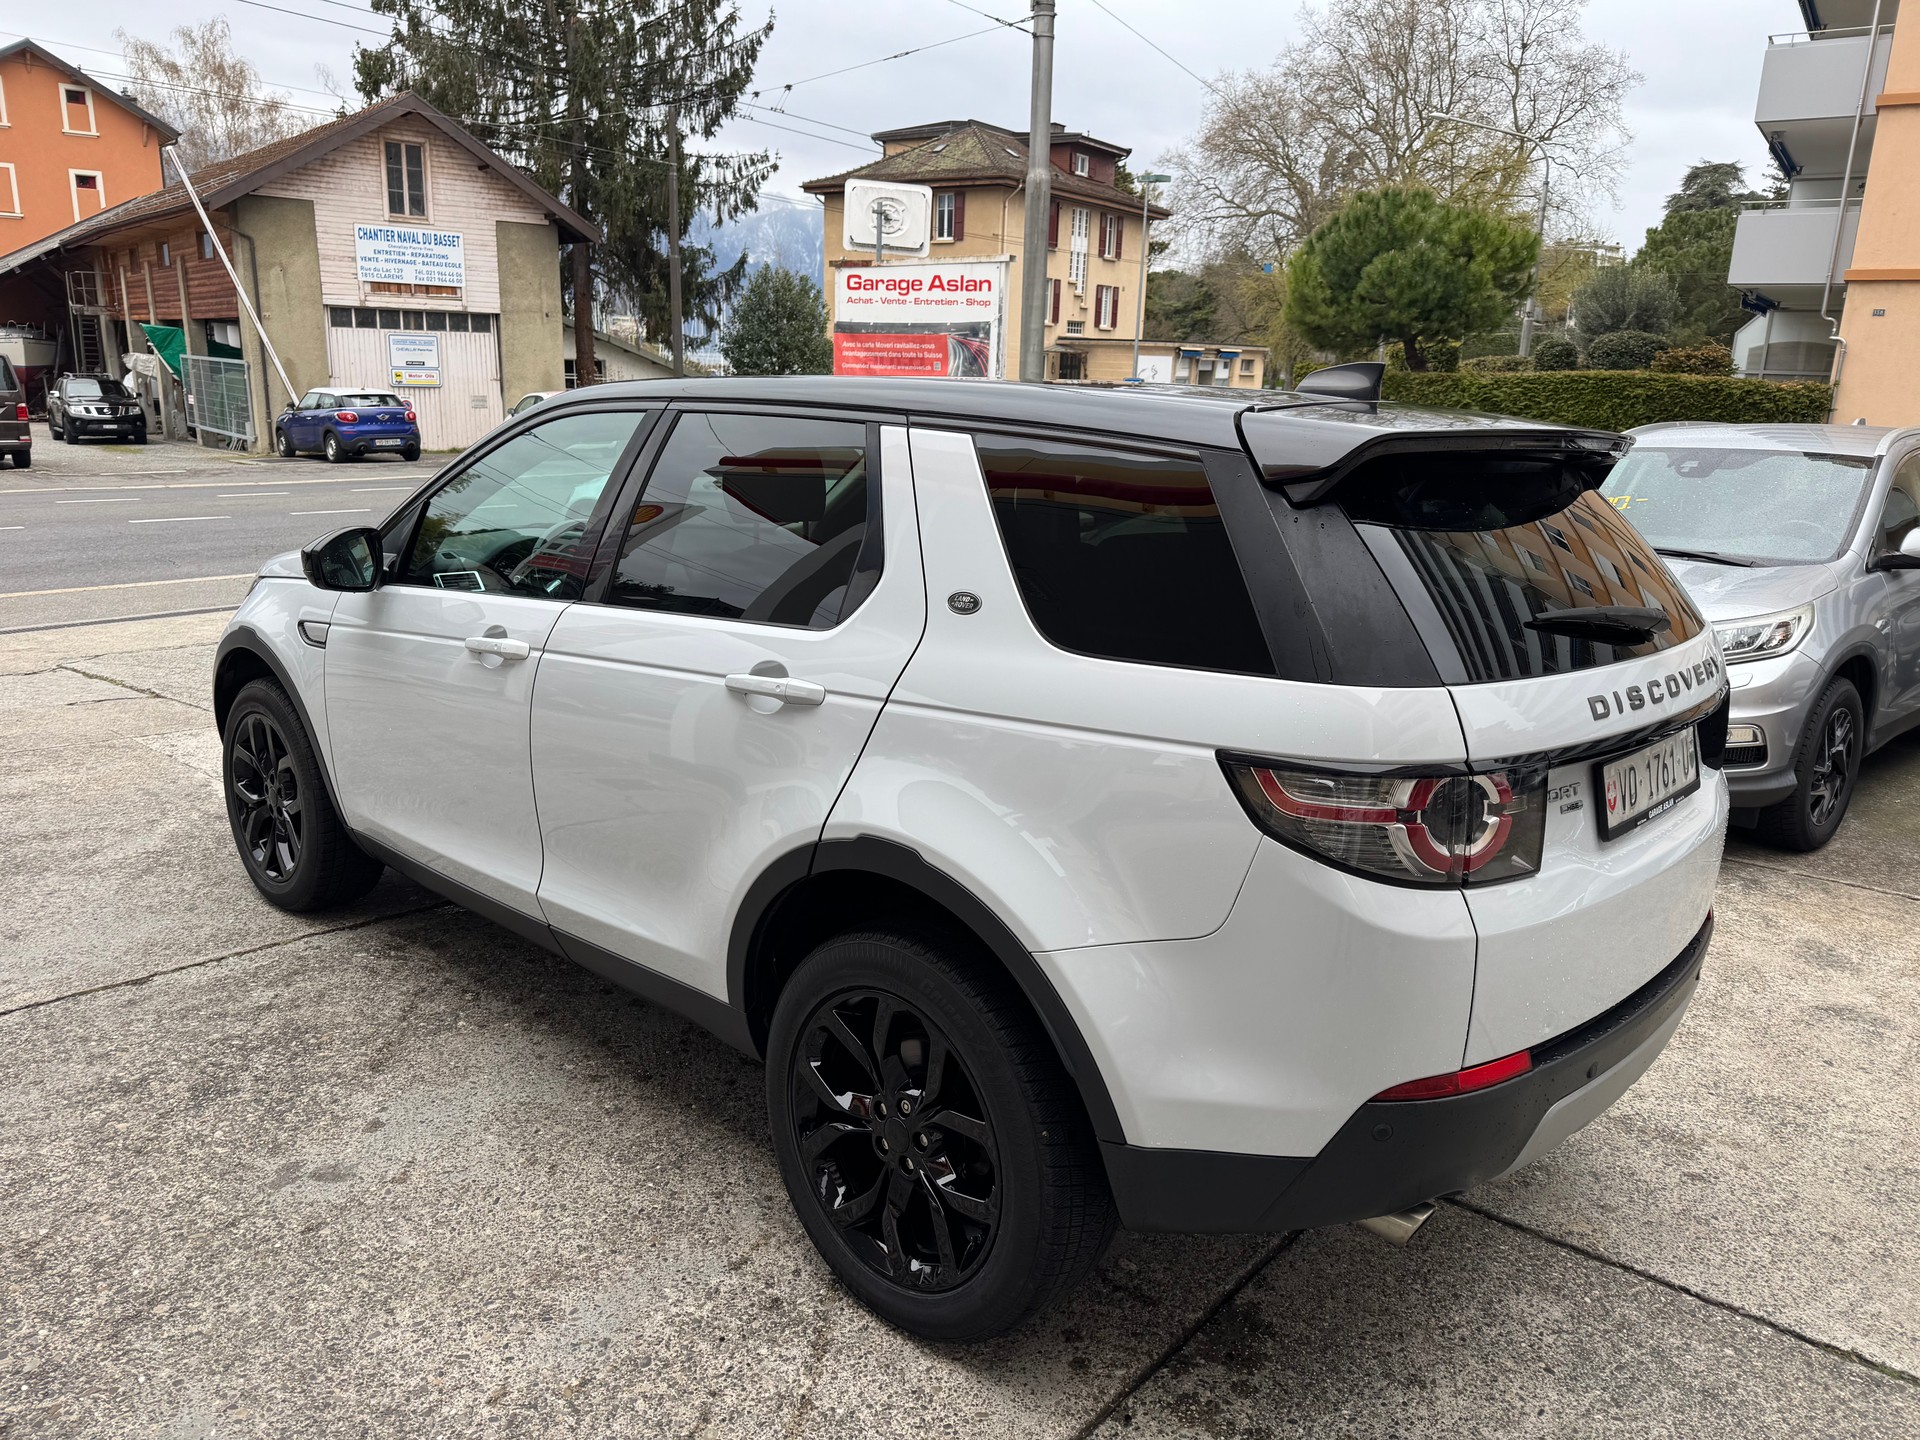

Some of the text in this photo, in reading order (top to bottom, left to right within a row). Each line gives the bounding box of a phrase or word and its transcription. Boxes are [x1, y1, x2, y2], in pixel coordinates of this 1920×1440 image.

[358, 228, 460, 248] CHANTIER NAVAL DU BASSET
[411, 252, 449, 260] REPARATIONS
[846, 274, 992, 296] Garage Aslan
[880, 297, 907, 305] Vente
[914, 298, 958, 306] Entretien
[966, 298, 991, 308] Shop
[1586, 656, 1720, 721] DISCOVERY
[1617, 765, 1638, 816] VD
[1645, 748, 1677, 799] 1761
[1648, 804, 1663, 818] GARAGE
